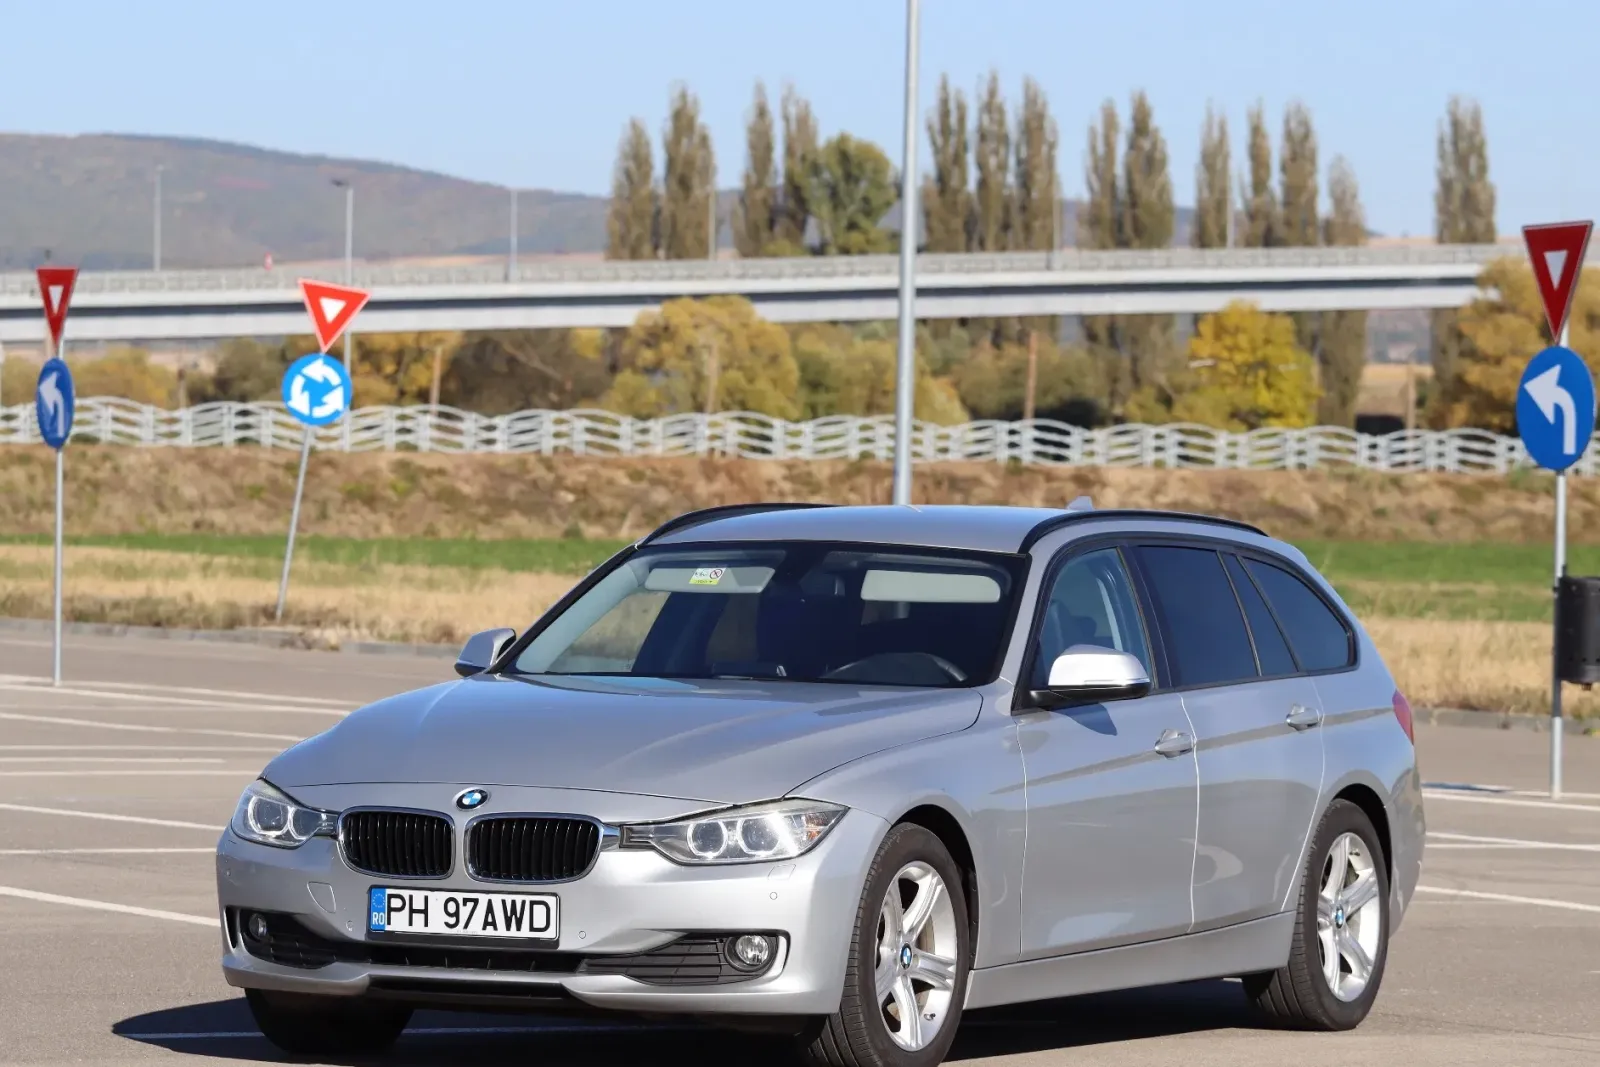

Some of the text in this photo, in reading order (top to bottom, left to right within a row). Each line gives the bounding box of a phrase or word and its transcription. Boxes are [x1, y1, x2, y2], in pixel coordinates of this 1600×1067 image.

[372, 912, 385, 925] RO
[387, 894, 551, 932] PH 97AWD
